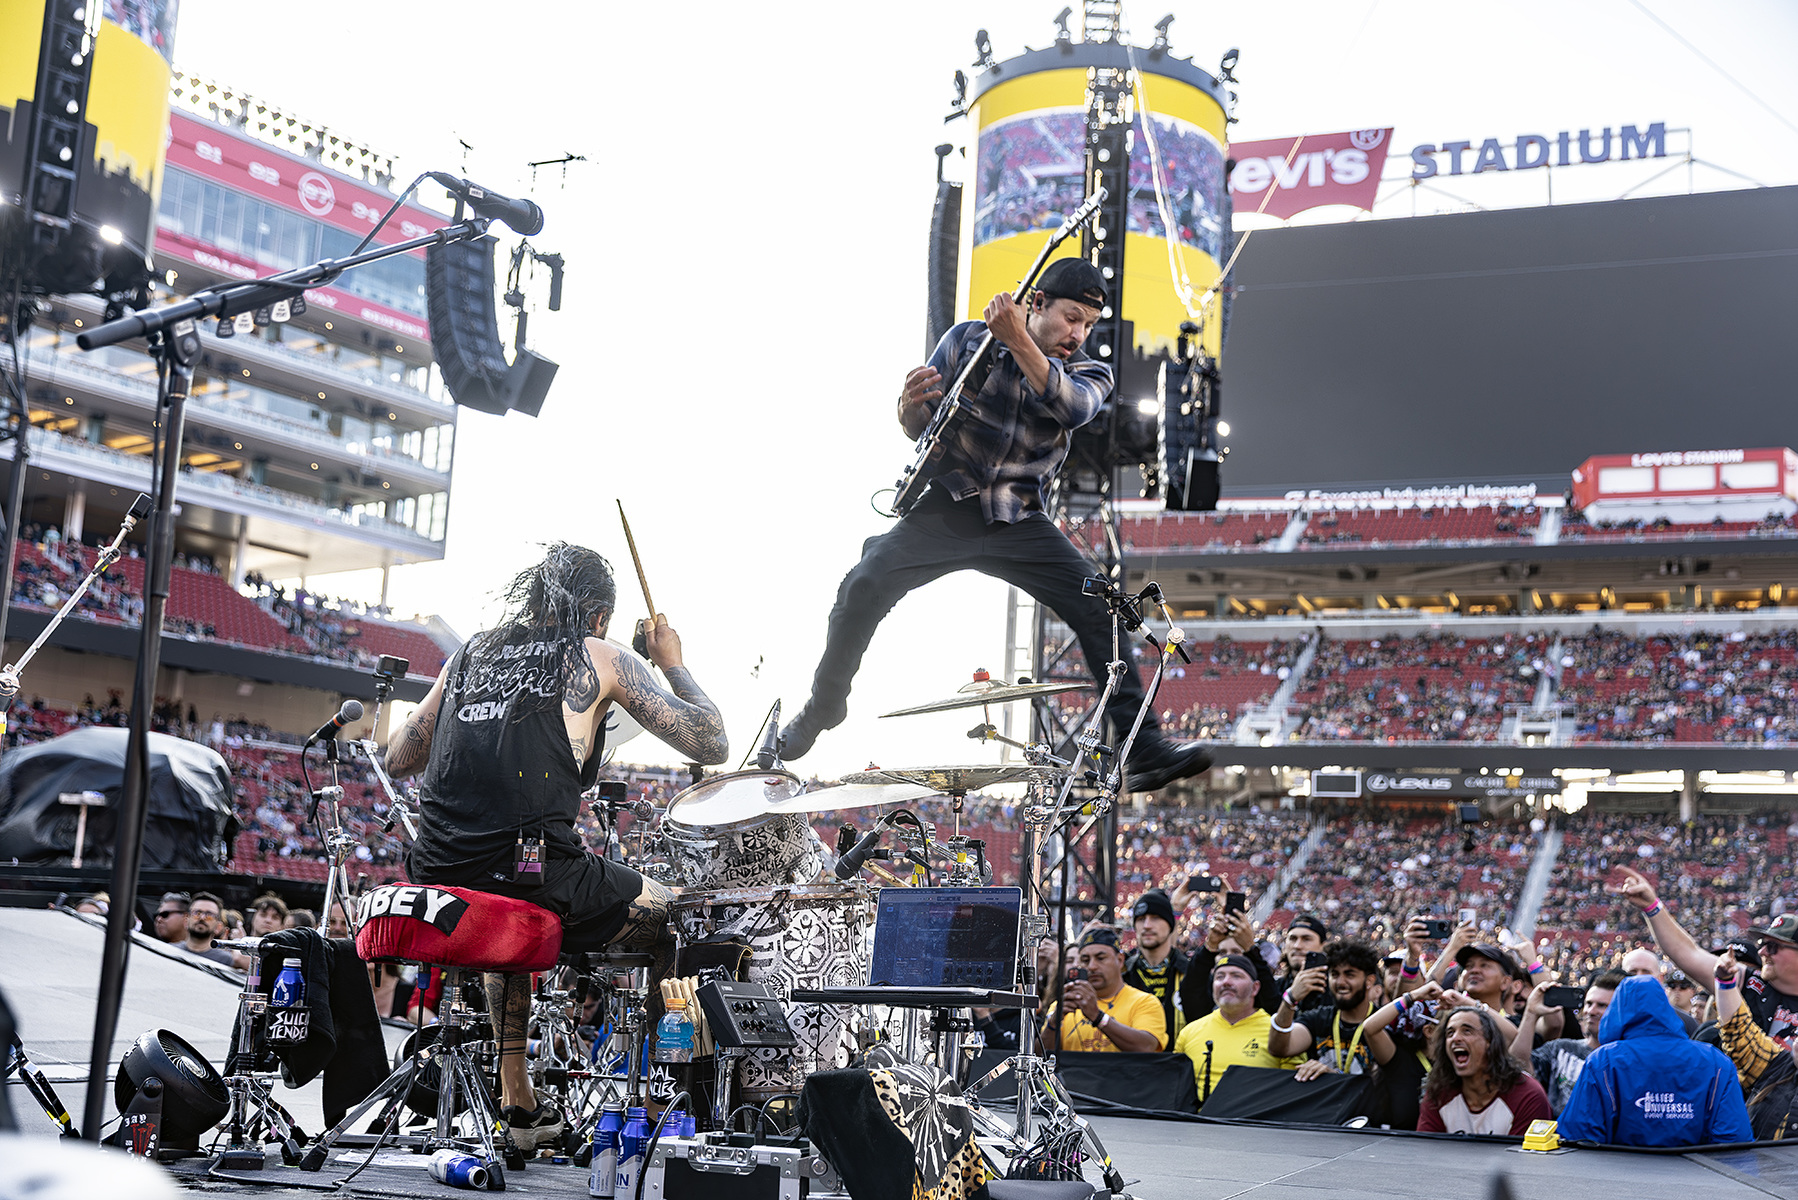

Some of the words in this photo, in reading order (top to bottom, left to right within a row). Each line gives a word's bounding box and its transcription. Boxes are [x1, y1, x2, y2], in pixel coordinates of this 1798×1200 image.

[1411, 122, 1666, 180] STADIUM
[1228, 147, 1370, 194] evi's
[1383, 483, 1466, 500] Industrial
[1467, 481, 1537, 500] Internet
[457, 700, 509, 722] CREW
[1389, 777, 1452, 790] LEXUS
[357, 886, 458, 929] OBEY
[271, 1010, 310, 1026] SUIC
[268, 1025, 308, 1041] TENDE
[1645, 1091, 1675, 1103] ALLIED
[1644, 1101, 1694, 1113] UNIVERSAL
